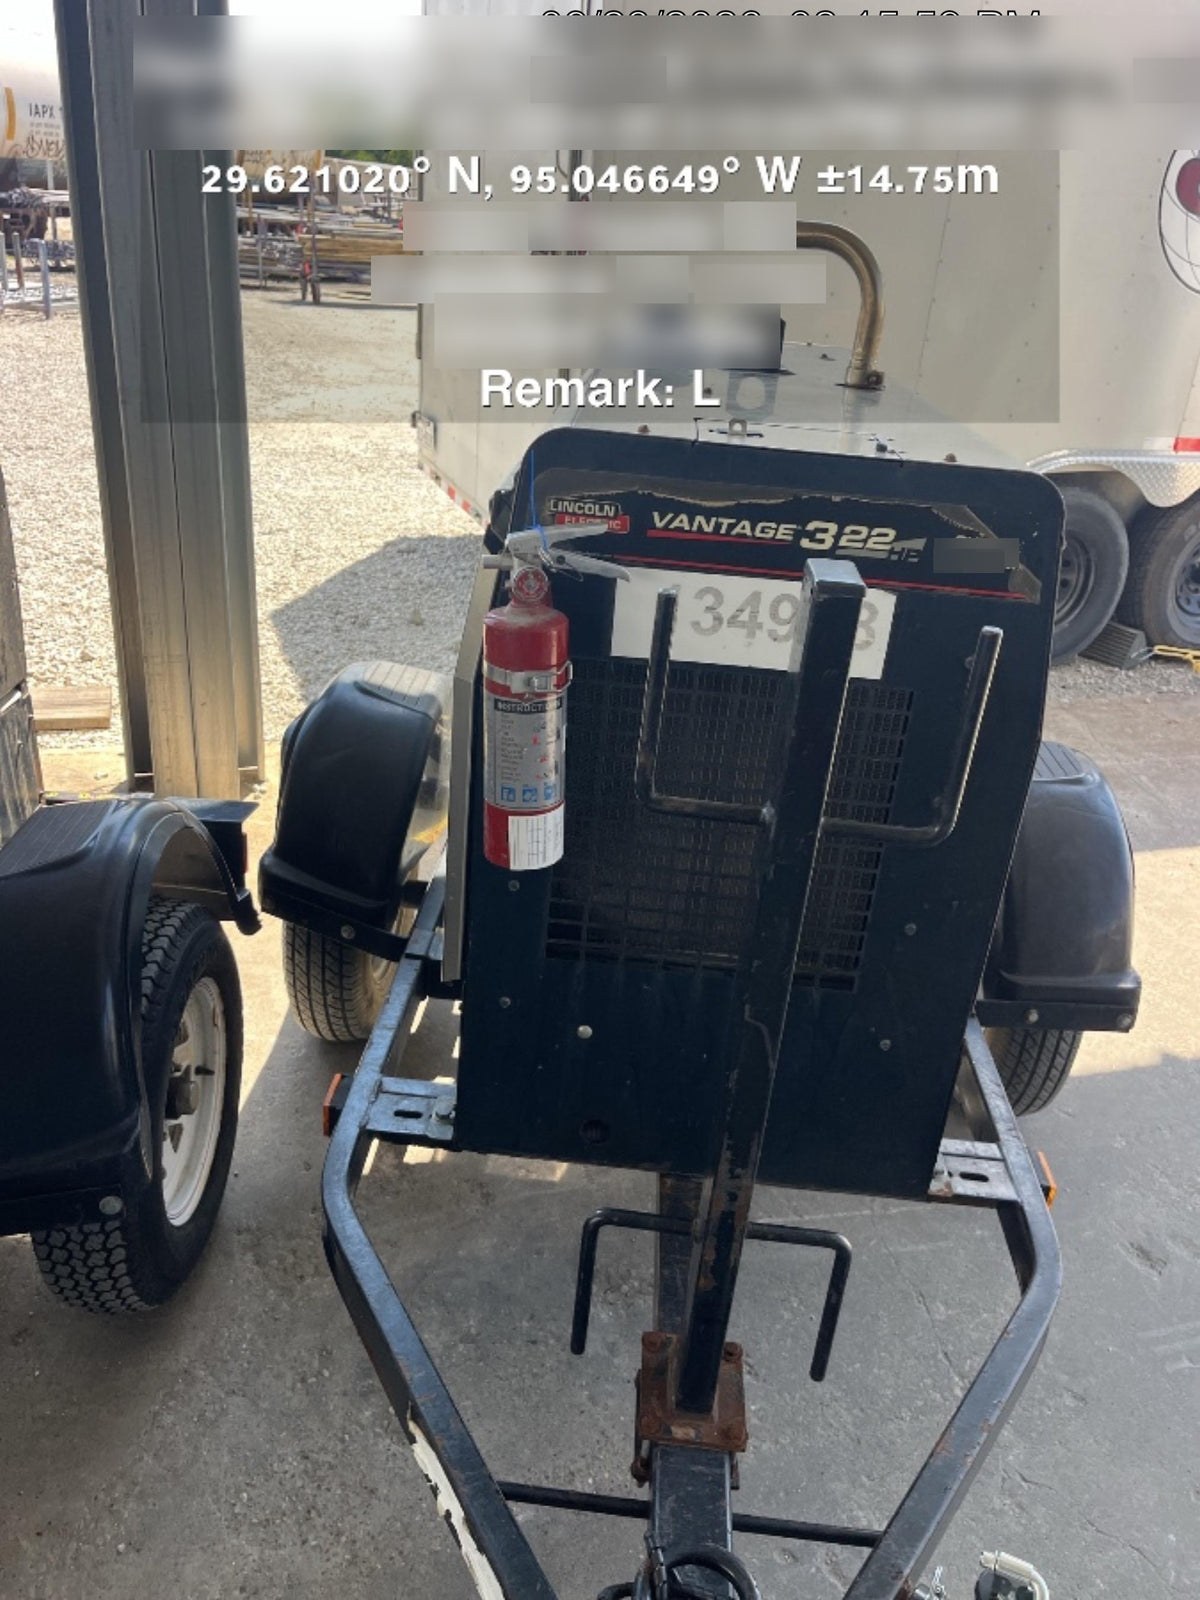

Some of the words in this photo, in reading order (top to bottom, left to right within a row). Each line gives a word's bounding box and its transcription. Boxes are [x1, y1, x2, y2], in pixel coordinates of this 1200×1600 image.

[550, 499, 615, 517] LINCOLN
[652, 511, 797, 541] VANTAGE
[799, 520, 897, 550] 322
[673, 584, 879, 651] 3493
